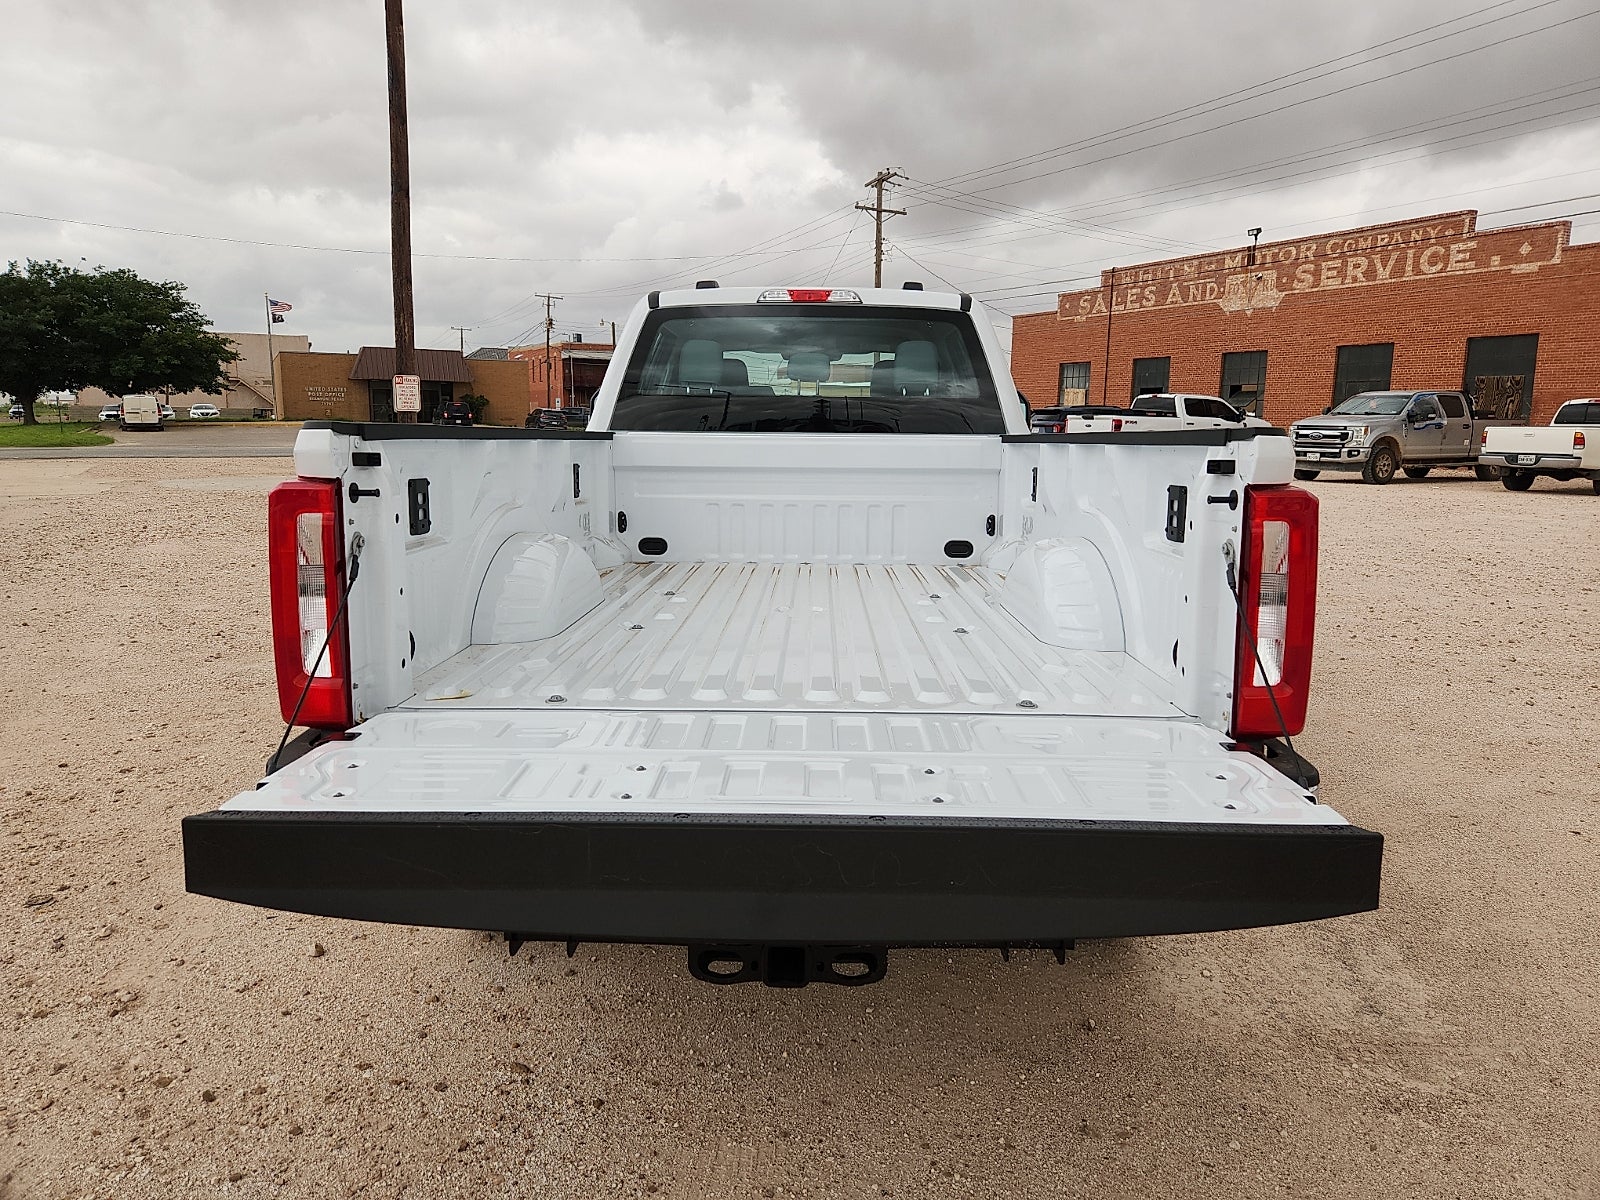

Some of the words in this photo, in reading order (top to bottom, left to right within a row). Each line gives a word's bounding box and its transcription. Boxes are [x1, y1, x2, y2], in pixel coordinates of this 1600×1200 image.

[1325, 225, 1444, 257] COMPANY
[1078, 286, 1157, 315] SALES
[1165, 282, 1219, 305] AND
[1292, 240, 1478, 289] SERVICE
